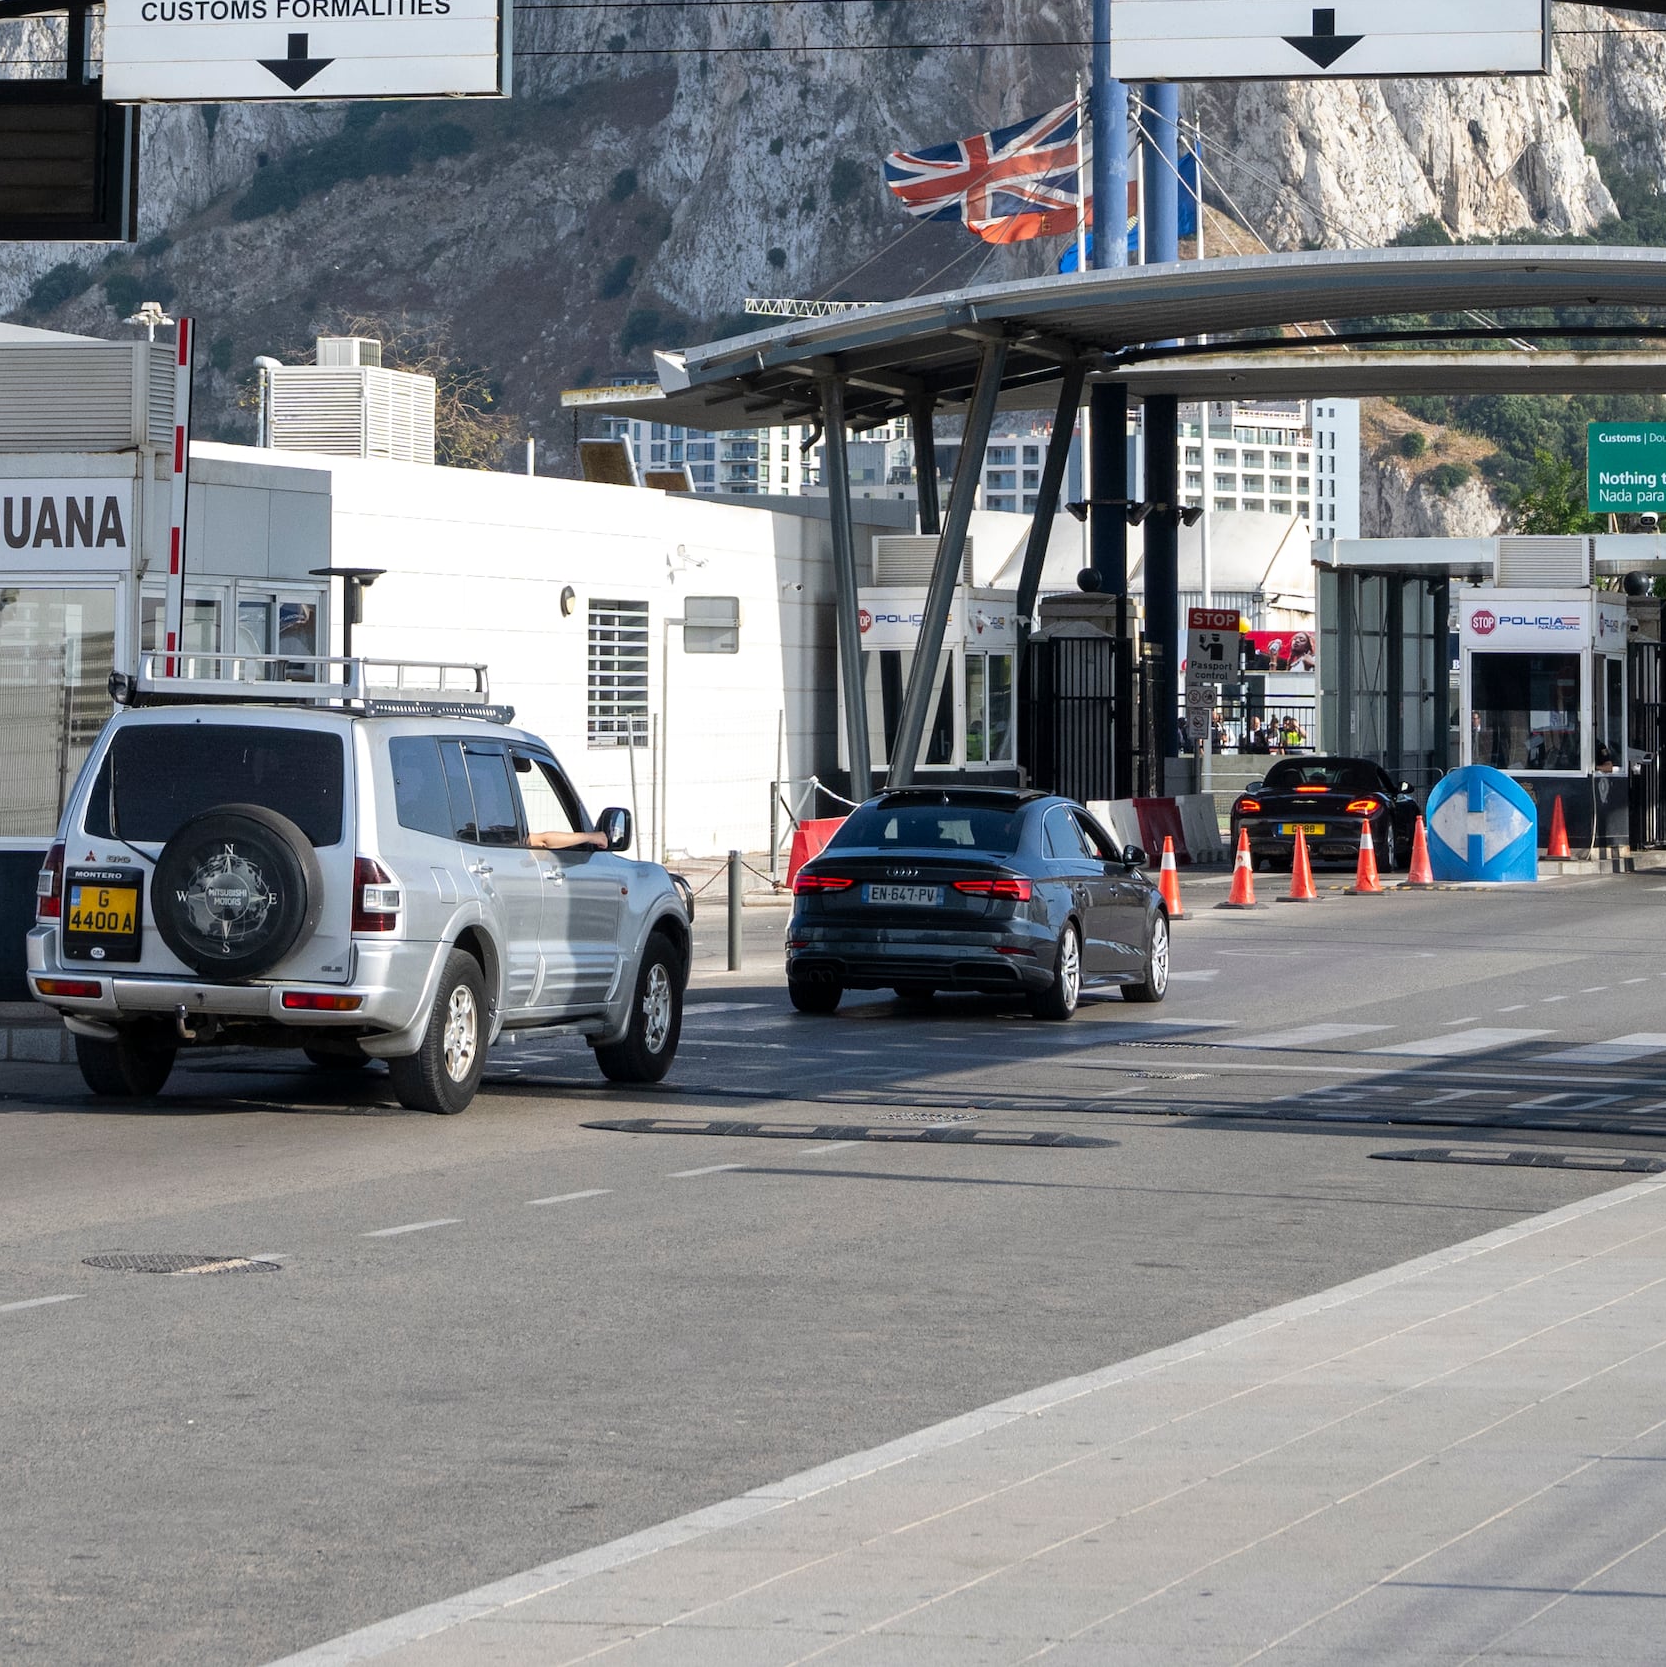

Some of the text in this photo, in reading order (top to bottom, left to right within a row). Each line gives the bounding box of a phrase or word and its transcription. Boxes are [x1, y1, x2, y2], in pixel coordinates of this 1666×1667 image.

[142, 0, 266, 21] CUSTOMS
[1598, 432, 1641, 443] Customs
[1599, 471, 1656, 487] Nothing
[1599, 488, 1632, 502] Nada
[1636, 491, 1664, 505] para
[1193, 612, 1236, 627] STOP
[1472, 616, 1564, 628] STOP POLICIA
[1191, 660, 1232, 671] Passport
[1195, 670, 1228, 680] control
[224, 843, 234, 854] N
[75, 870, 122, 879] MONTERO
[98, 889, 110, 908] G
[176, 890, 189, 902] W
[208, 888, 248, 897] MITSUBISHI
[871, 884, 934, 902] EN-647-PV
[213, 897, 241, 906] MOTORS
[268, 893, 278, 905] E
[222, 941, 231, 953] S
